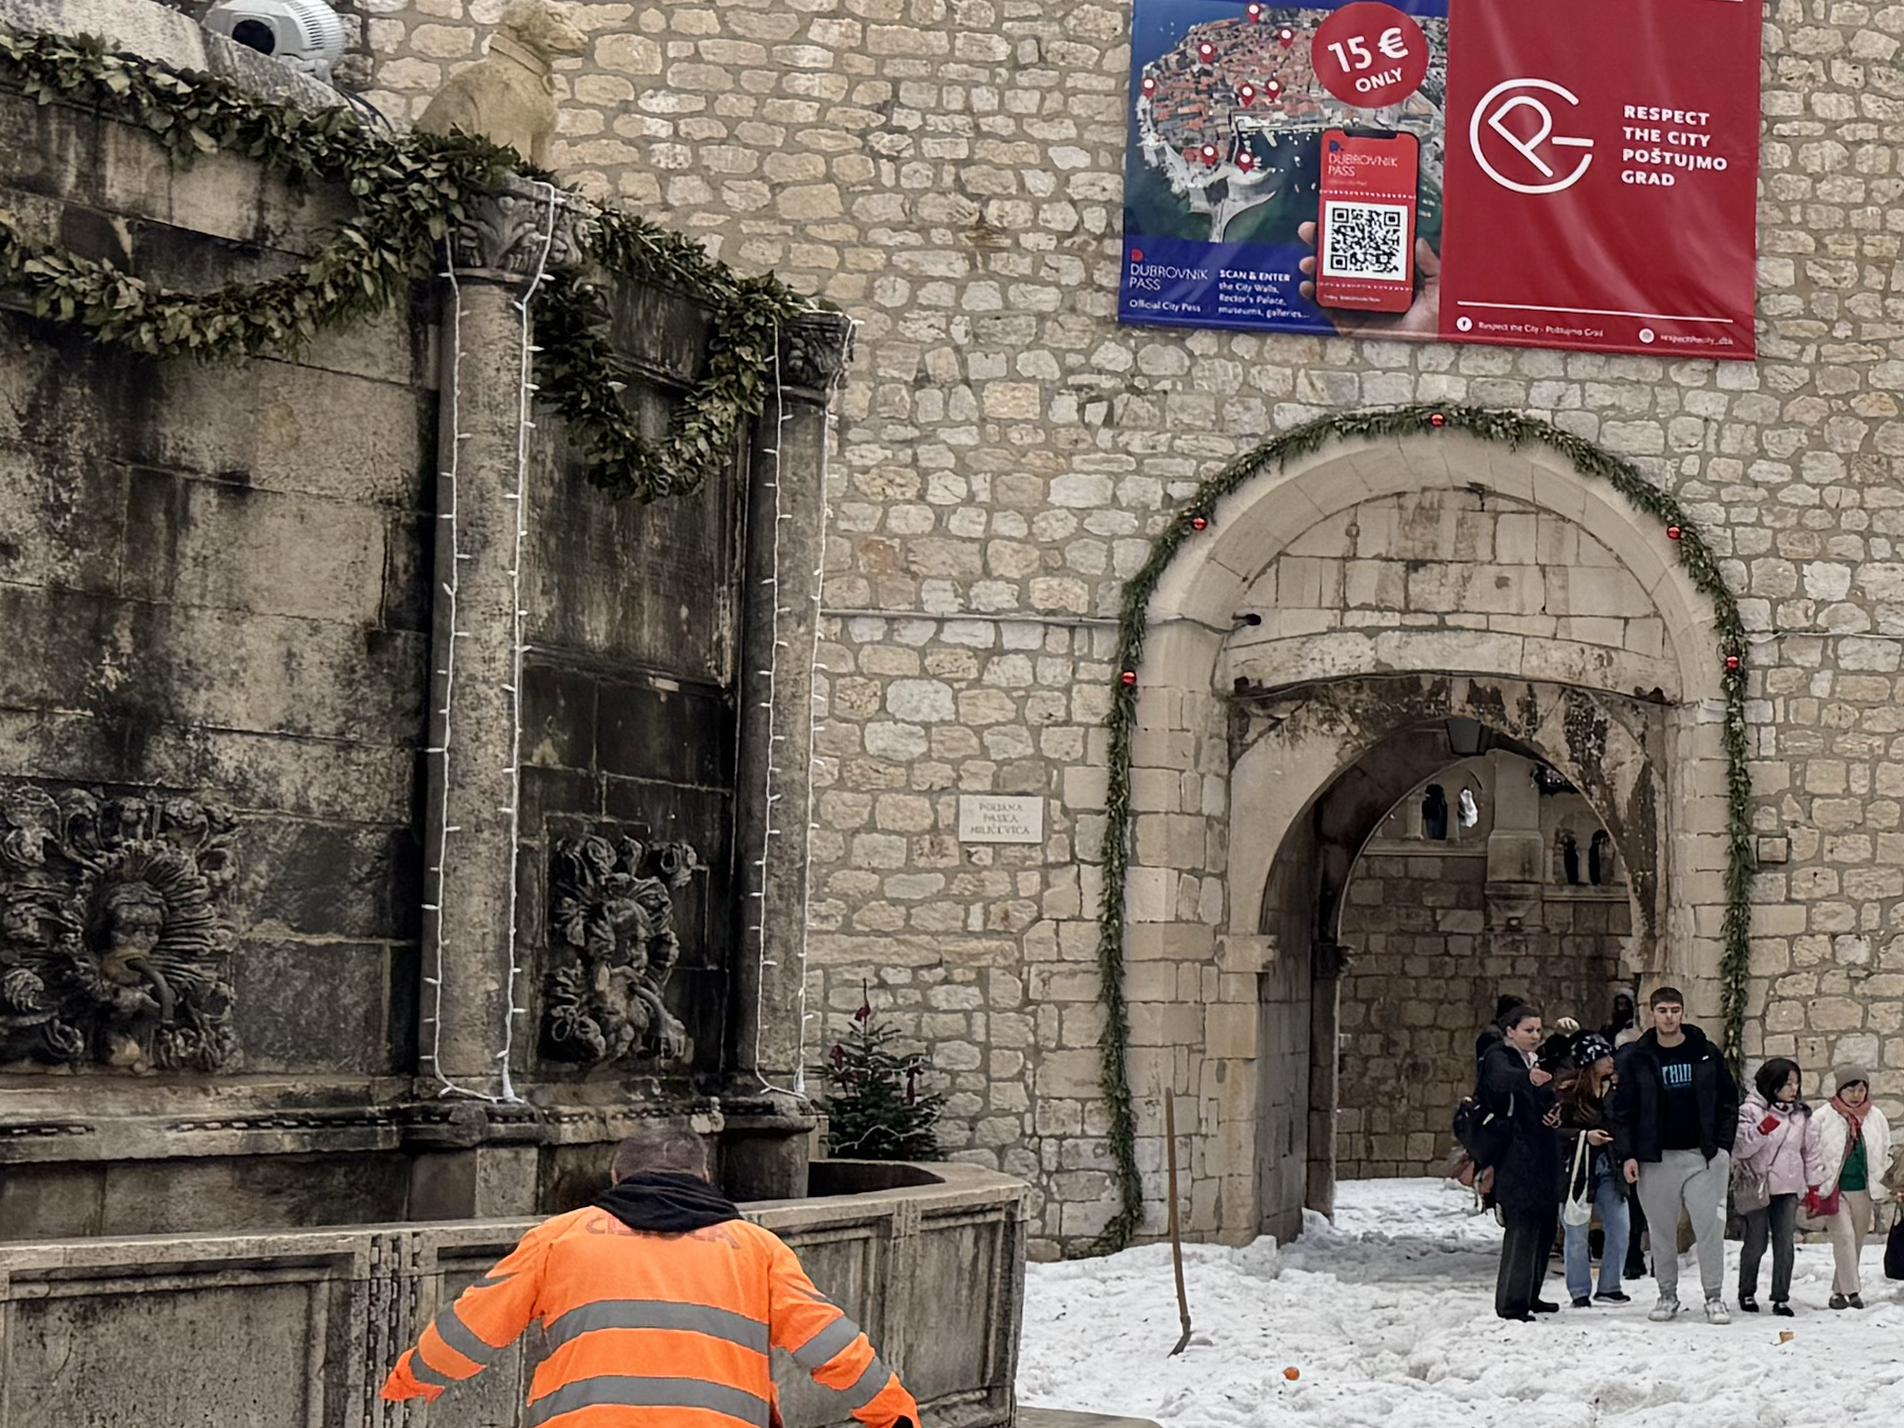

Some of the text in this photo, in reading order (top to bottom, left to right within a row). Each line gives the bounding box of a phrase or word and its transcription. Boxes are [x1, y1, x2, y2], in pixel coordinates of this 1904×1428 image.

[1327, 27, 1409, 73] 15 €
[1355, 67, 1402, 93] ONLY
[1623, 105, 1710, 125] RESPECT
[1623, 126, 1711, 148] THE CITY
[1328, 153, 1398, 168] DUBROVNIK
[1622, 147, 1728, 171] POŠTUJMO
[1328, 165, 1356, 177] PASS
[1621, 170, 1675, 187] GRAD
[1130, 262, 1209, 280] DUBROVNIK
[1219, 269, 1291, 282] SCAN & ENTER
[1129, 276, 1161, 291] PASS
[1219, 282, 1234, 290] the
[1235, 283, 1252, 293] City
[1129, 299, 1201, 312] Official City Pass
[1524, 324, 1539, 335] City
